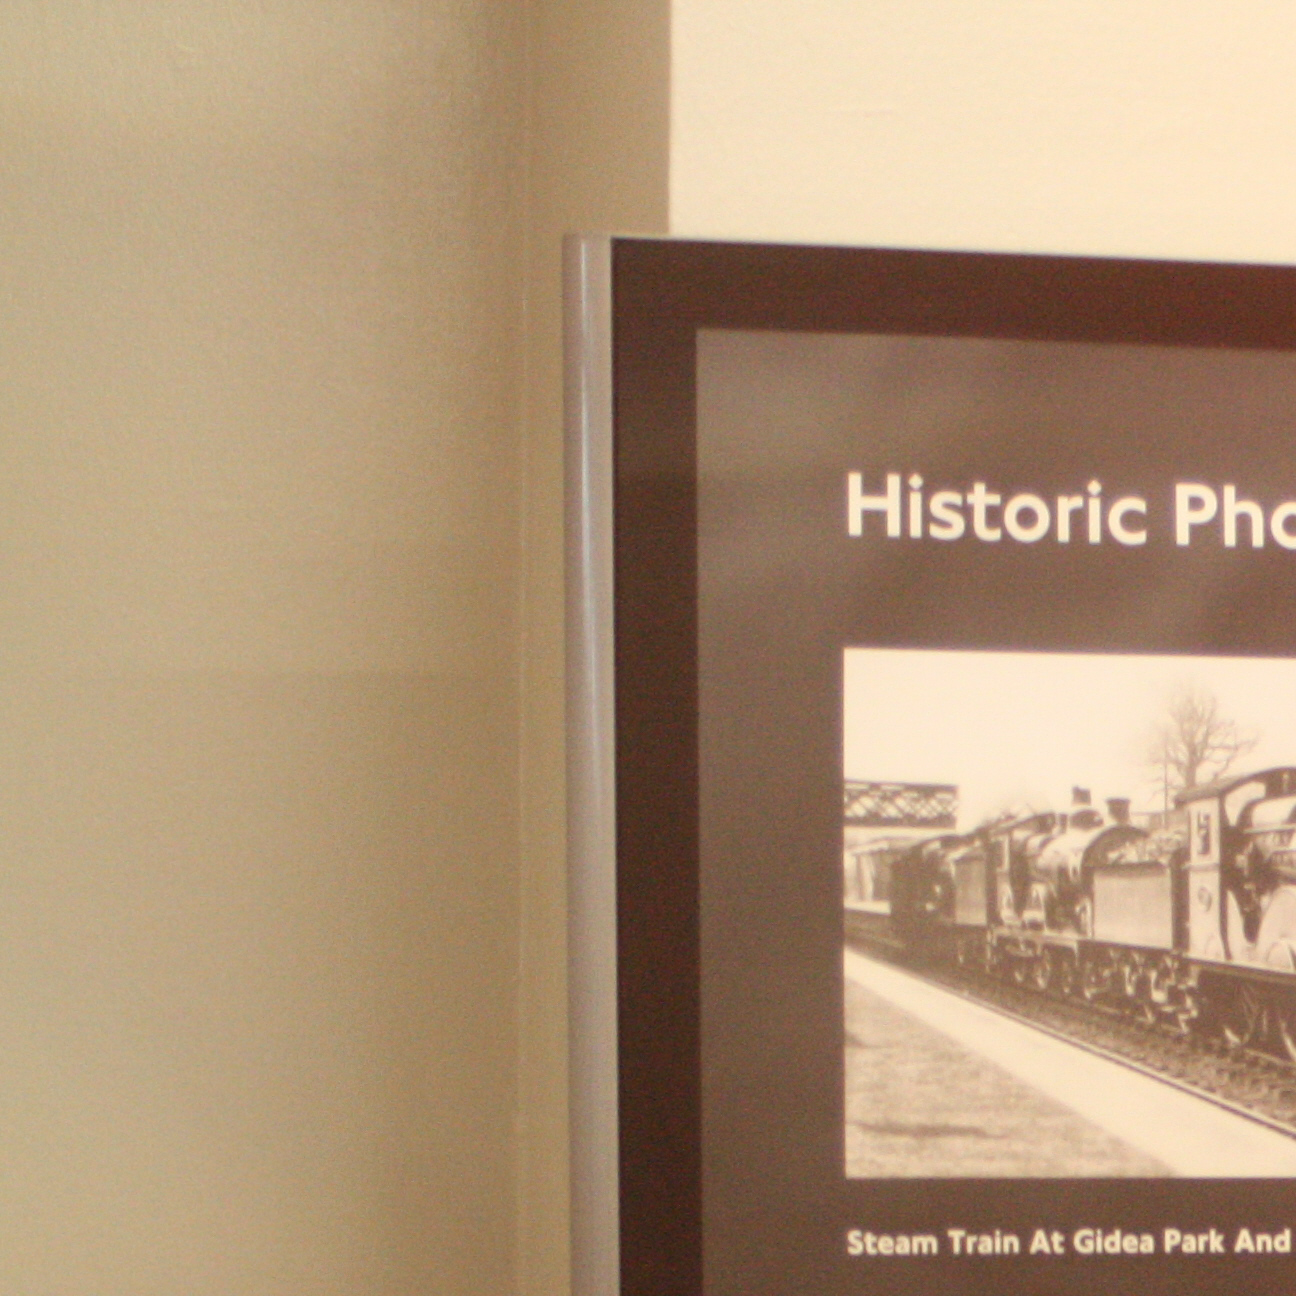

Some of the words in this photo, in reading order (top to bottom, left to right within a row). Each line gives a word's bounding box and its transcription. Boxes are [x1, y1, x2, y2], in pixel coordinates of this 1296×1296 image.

[846, 470, 1148, 546] Historic
[847, 1229, 939, 1256] Steam
[947, 1228, 1020, 1255] Train
[1029, 1228, 1065, 1255] At
[1072, 1227, 1155, 1255] Gidea
[1163, 1227, 1225, 1254] Park
[1233, 1227, 1292, 1254] And
